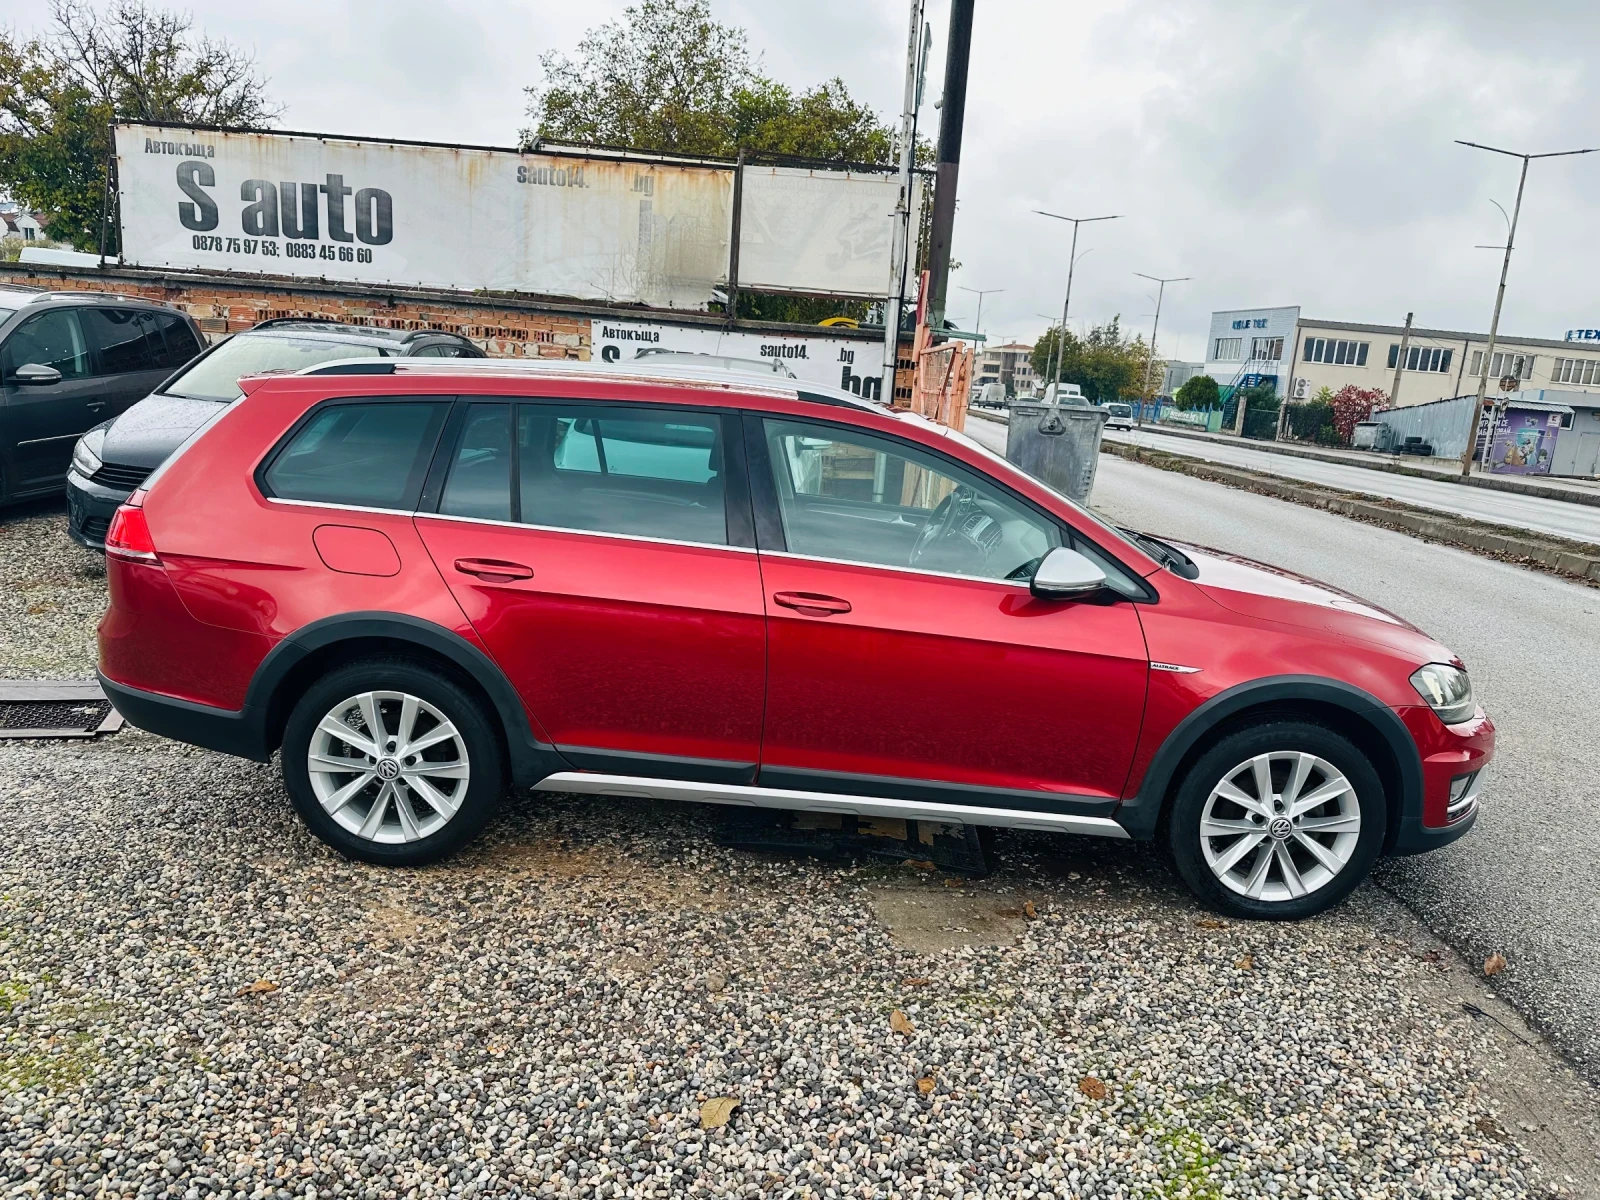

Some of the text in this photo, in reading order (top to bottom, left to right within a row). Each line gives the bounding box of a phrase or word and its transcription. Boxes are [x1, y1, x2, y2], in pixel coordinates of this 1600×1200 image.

[144, 138, 215, 159] Автокъща
[176, 160, 393, 245] S auto
[192, 234, 223, 252] 0878
[225, 237, 241, 254] 75
[243, 238, 259, 255] 97
[285, 242, 316, 259] 0883
[319, 244, 336, 261] 45
[338, 246, 354, 263] 66
[356, 247, 373, 264] 60
[601, 325, 660, 344] Автокъща
[760, 343, 855, 365] sauto14. .bg
